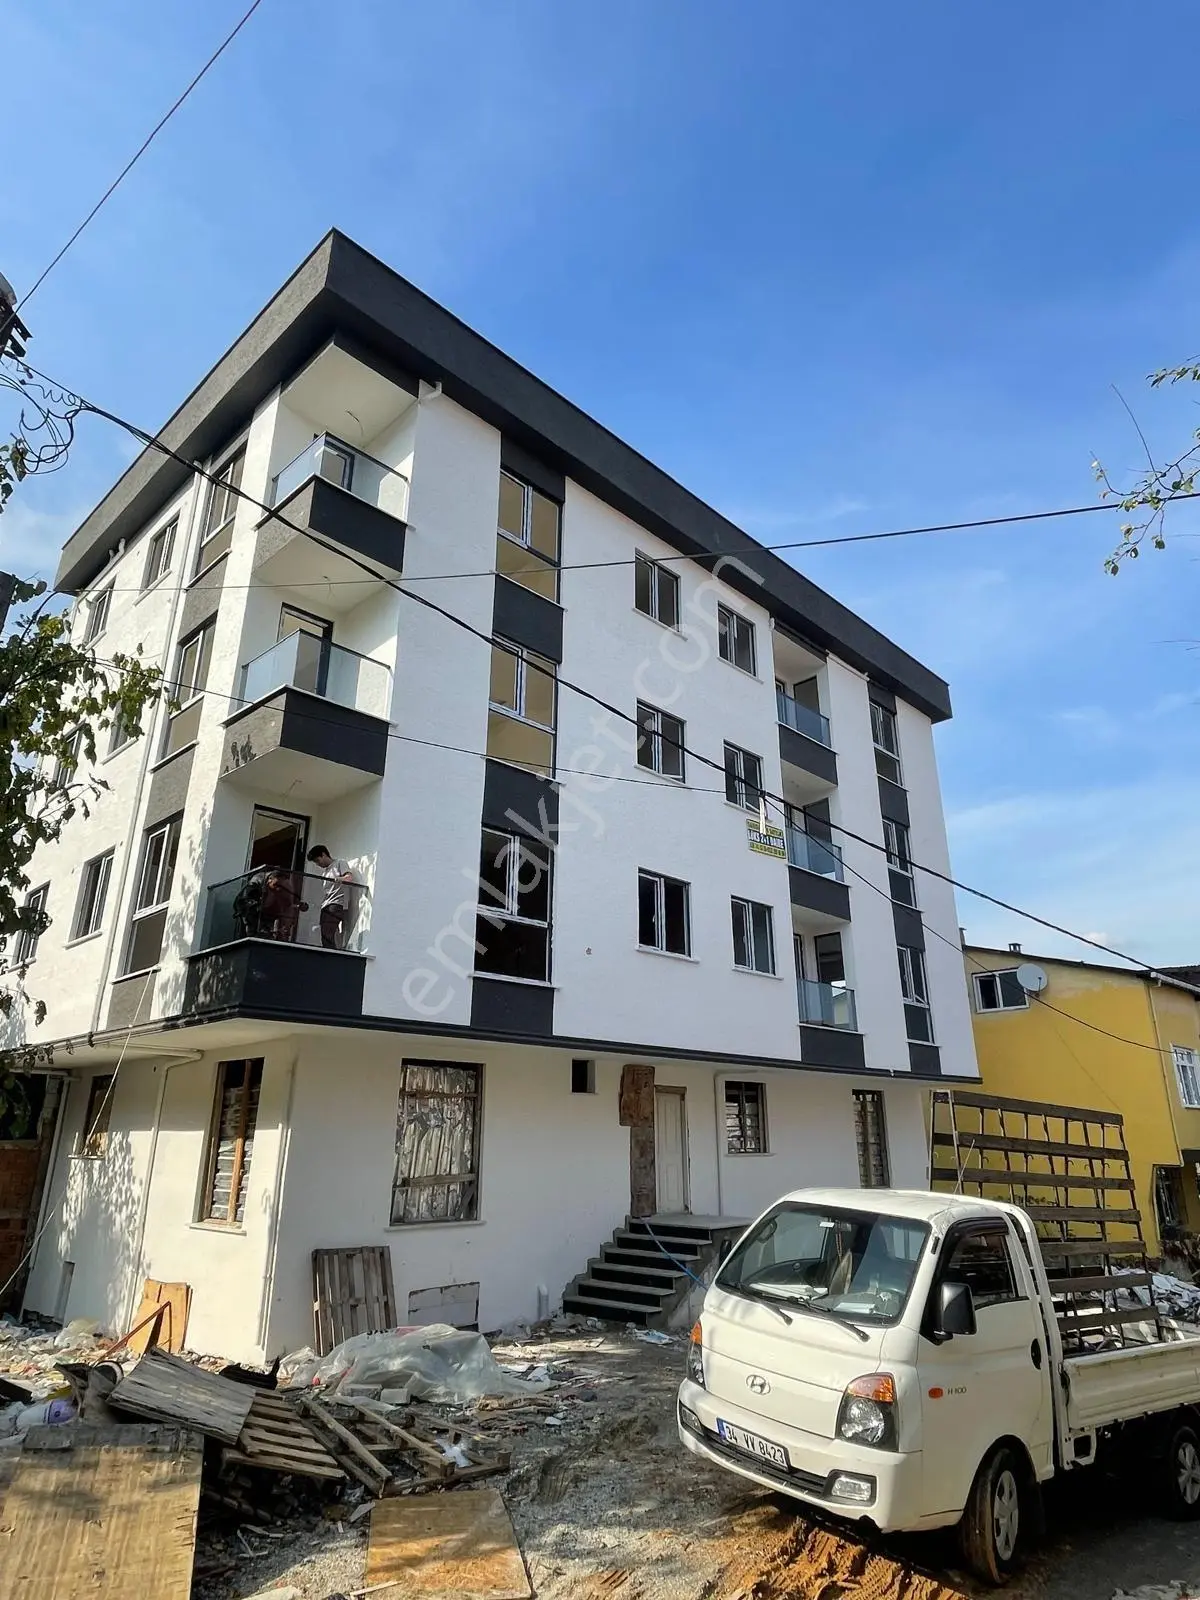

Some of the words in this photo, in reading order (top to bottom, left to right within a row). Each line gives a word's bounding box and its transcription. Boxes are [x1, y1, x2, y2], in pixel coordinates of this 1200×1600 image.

[726, 1425, 738, 1443] 34
[743, 1433, 756, 1451] VV
[758, 1440, 785, 1464] 8423
